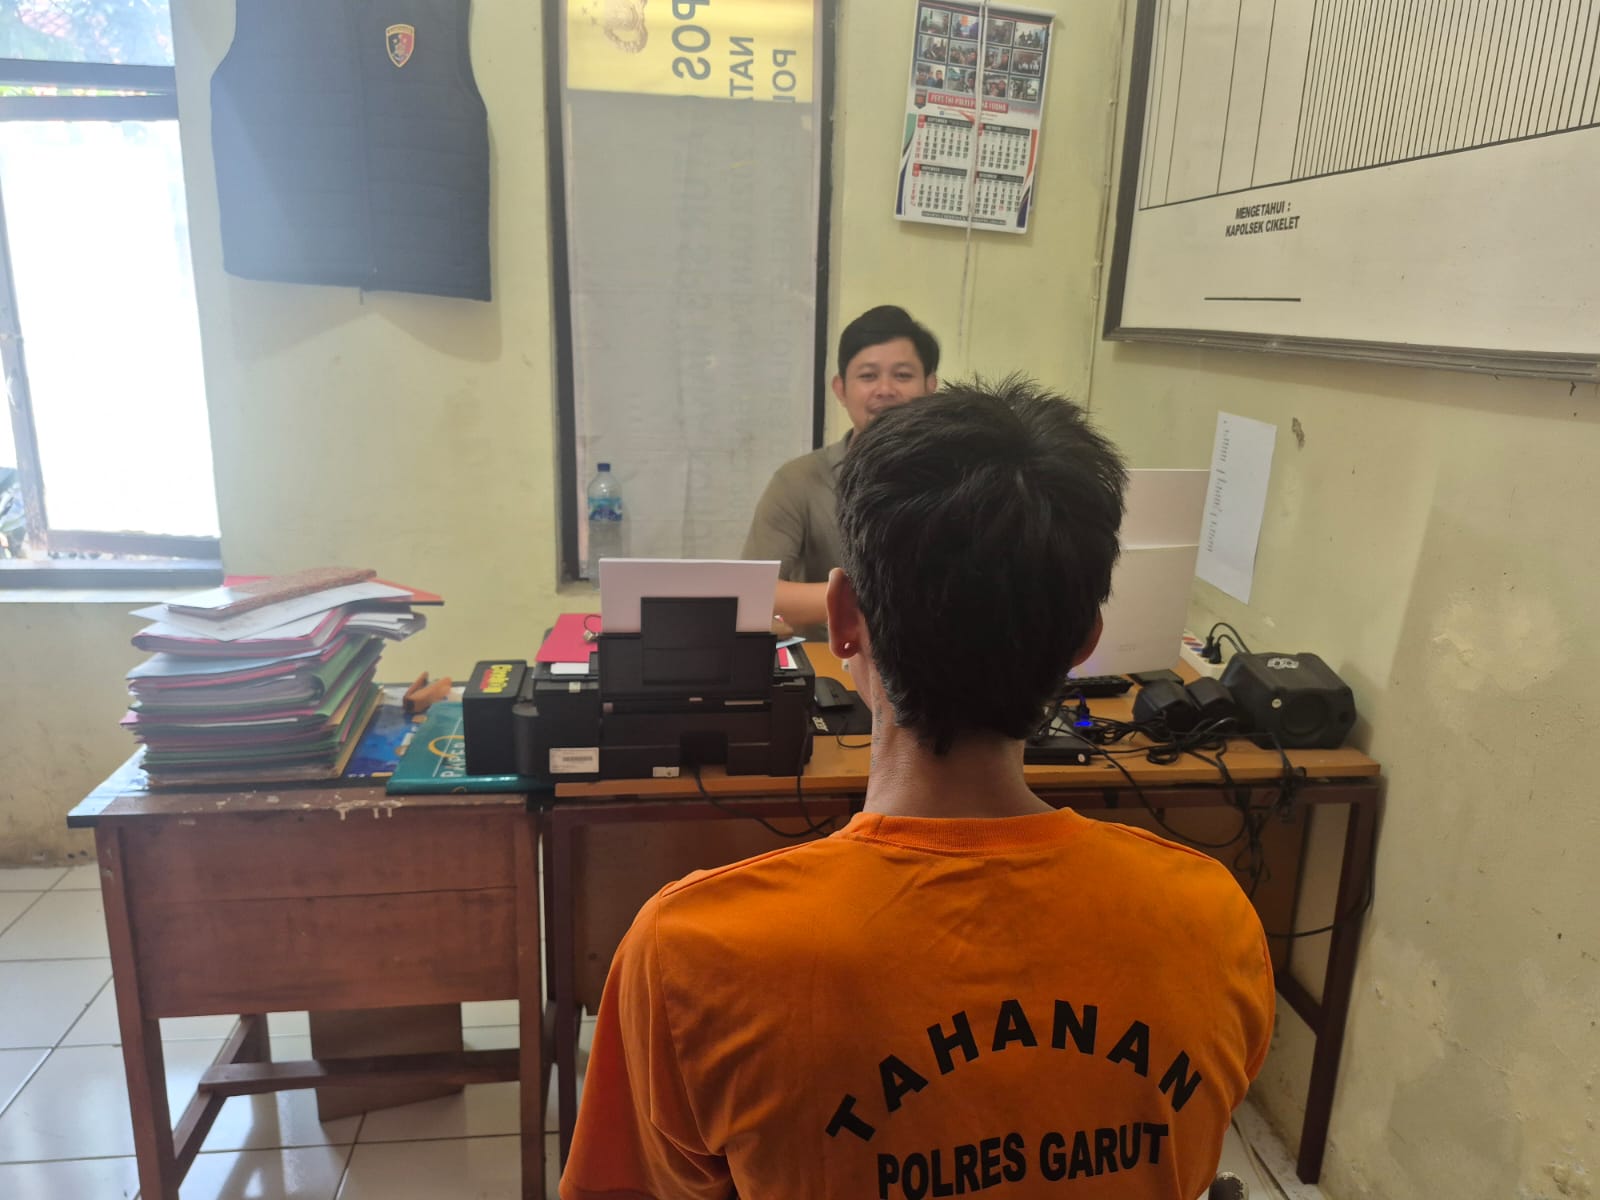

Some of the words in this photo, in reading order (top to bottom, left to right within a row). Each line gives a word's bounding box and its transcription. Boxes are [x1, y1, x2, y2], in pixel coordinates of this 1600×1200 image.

[1225, 221, 1265, 237] KAPOLSEK
[1265, 215, 1300, 232] CIKELET
[1235, 201, 1286, 219] MENGETAHUI
[825, 999, 1202, 1142] TAHANAN
[877, 1132, 1026, 1200] POLRES
[1040, 1122, 1168, 1182] GARUT
